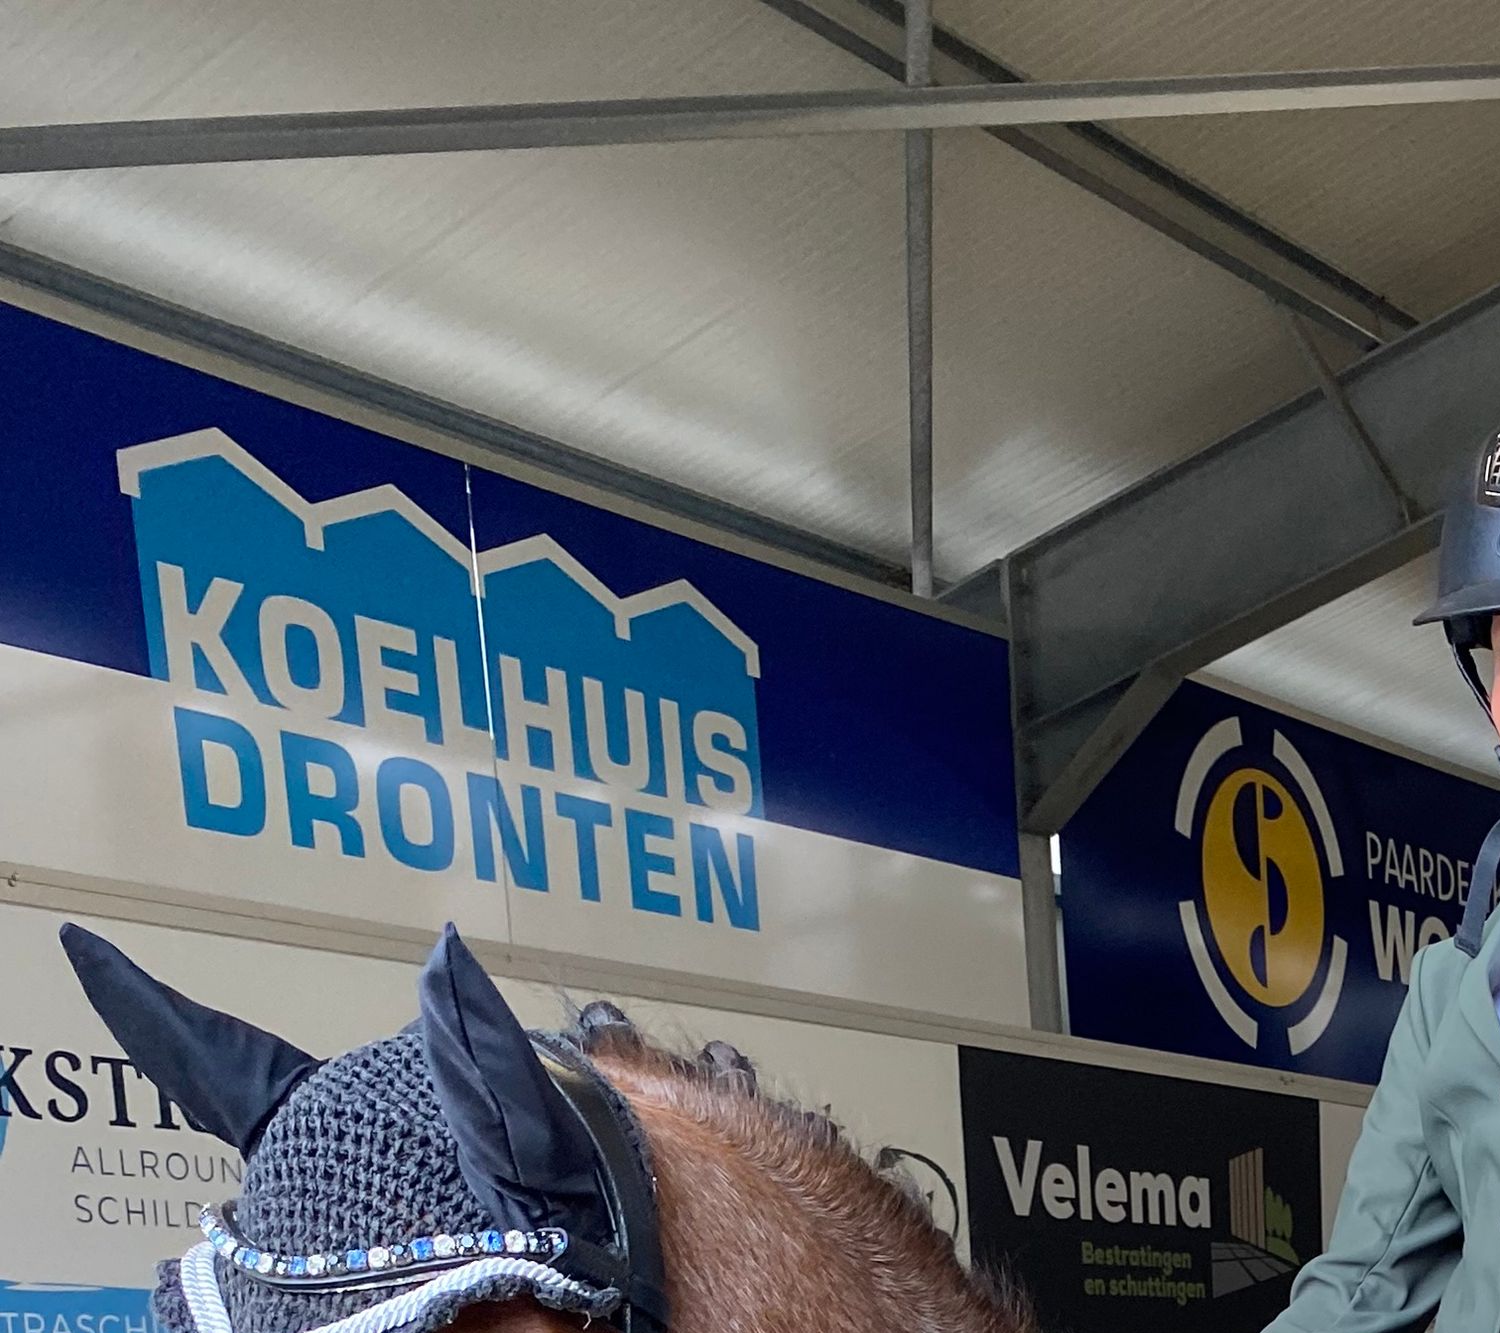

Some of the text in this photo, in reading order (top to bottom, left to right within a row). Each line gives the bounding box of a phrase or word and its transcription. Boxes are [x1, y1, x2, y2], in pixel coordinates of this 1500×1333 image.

[156, 560, 755, 817] KOELHUIS
[173, 706, 760, 931] DRONTEN
[72, 1146, 243, 1183] ALLROUN
[992, 1136, 1211, 1228] Velema
[75, 1194, 203, 1229] SCHILD
[1082, 1241, 1192, 1276] Bestratingen
[1084, 1274, 1206, 1306] en schuttingen
